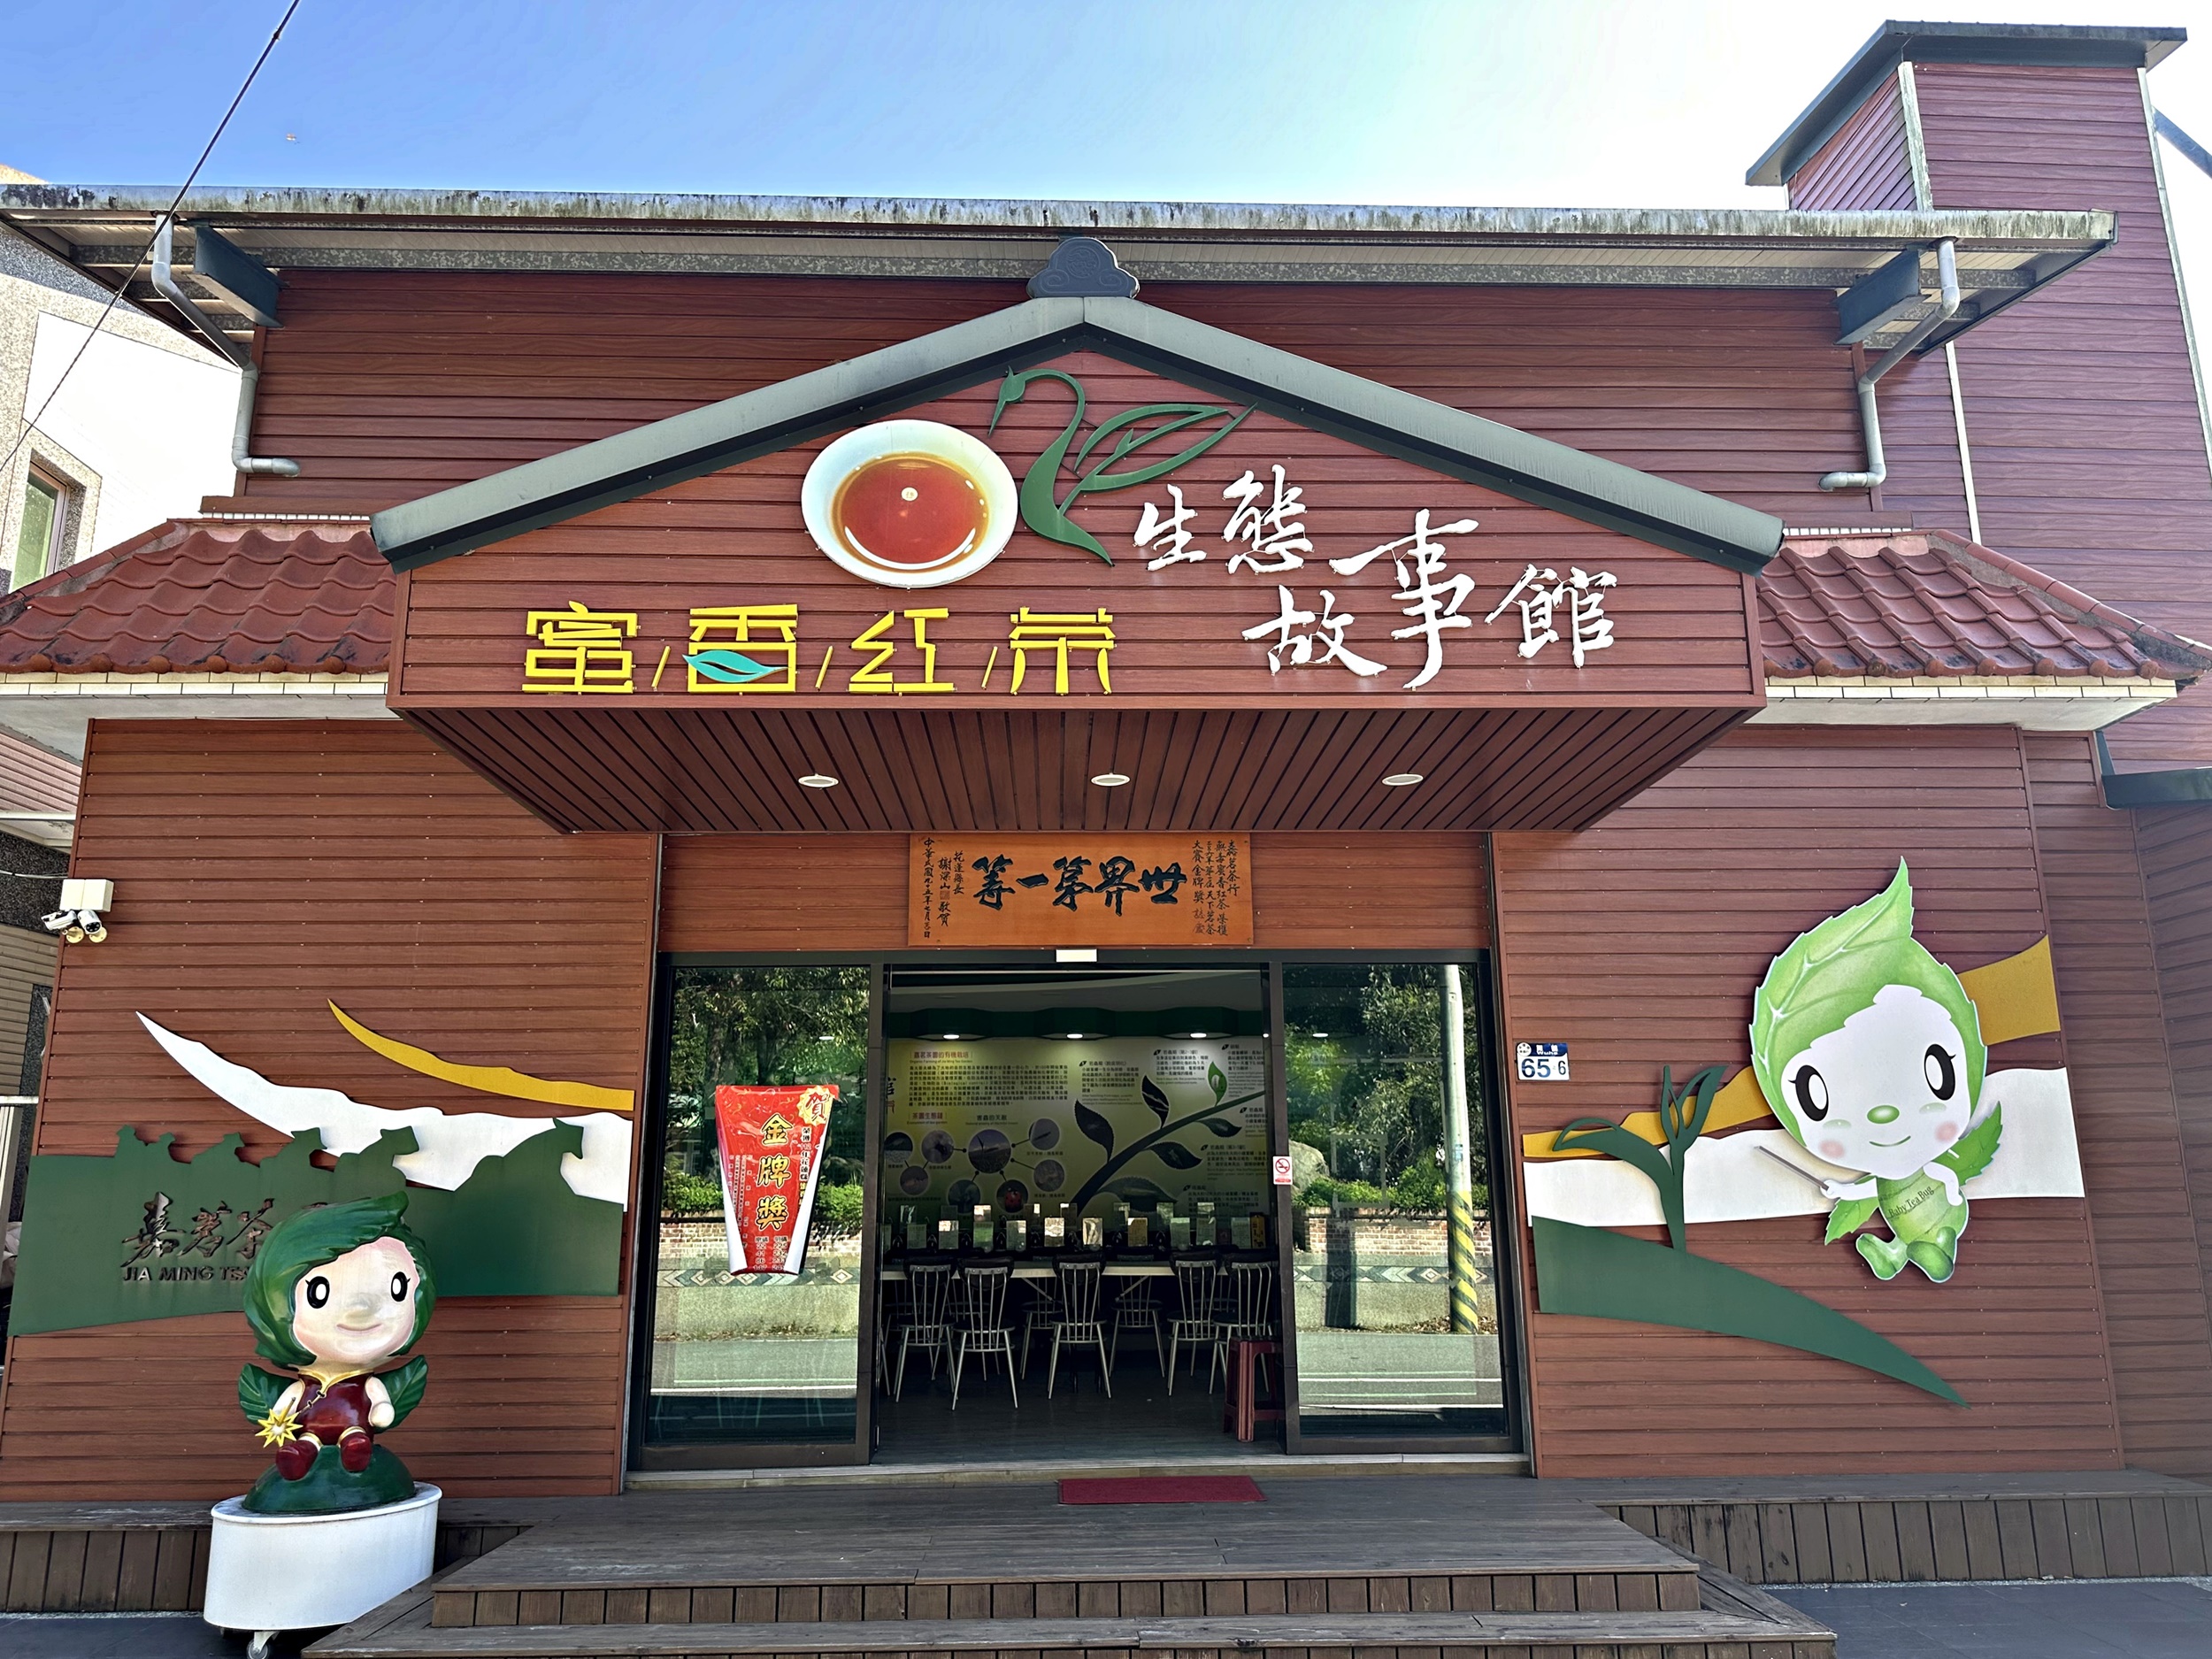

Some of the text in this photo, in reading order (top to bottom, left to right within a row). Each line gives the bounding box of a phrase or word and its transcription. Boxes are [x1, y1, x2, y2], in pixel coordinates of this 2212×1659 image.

[972, 854, 1187, 917] 世界第一等
[804, 1093, 830, 1123] 賀
[756, 1114, 794, 1231] 金牌獎
[1887, 1186, 1935, 1217] Baby Tea Bug
[120, 1191, 328, 1267] 嘉茗茶
[123, 1266, 152, 1281] JIA
[158, 1266, 215, 1281] MING
